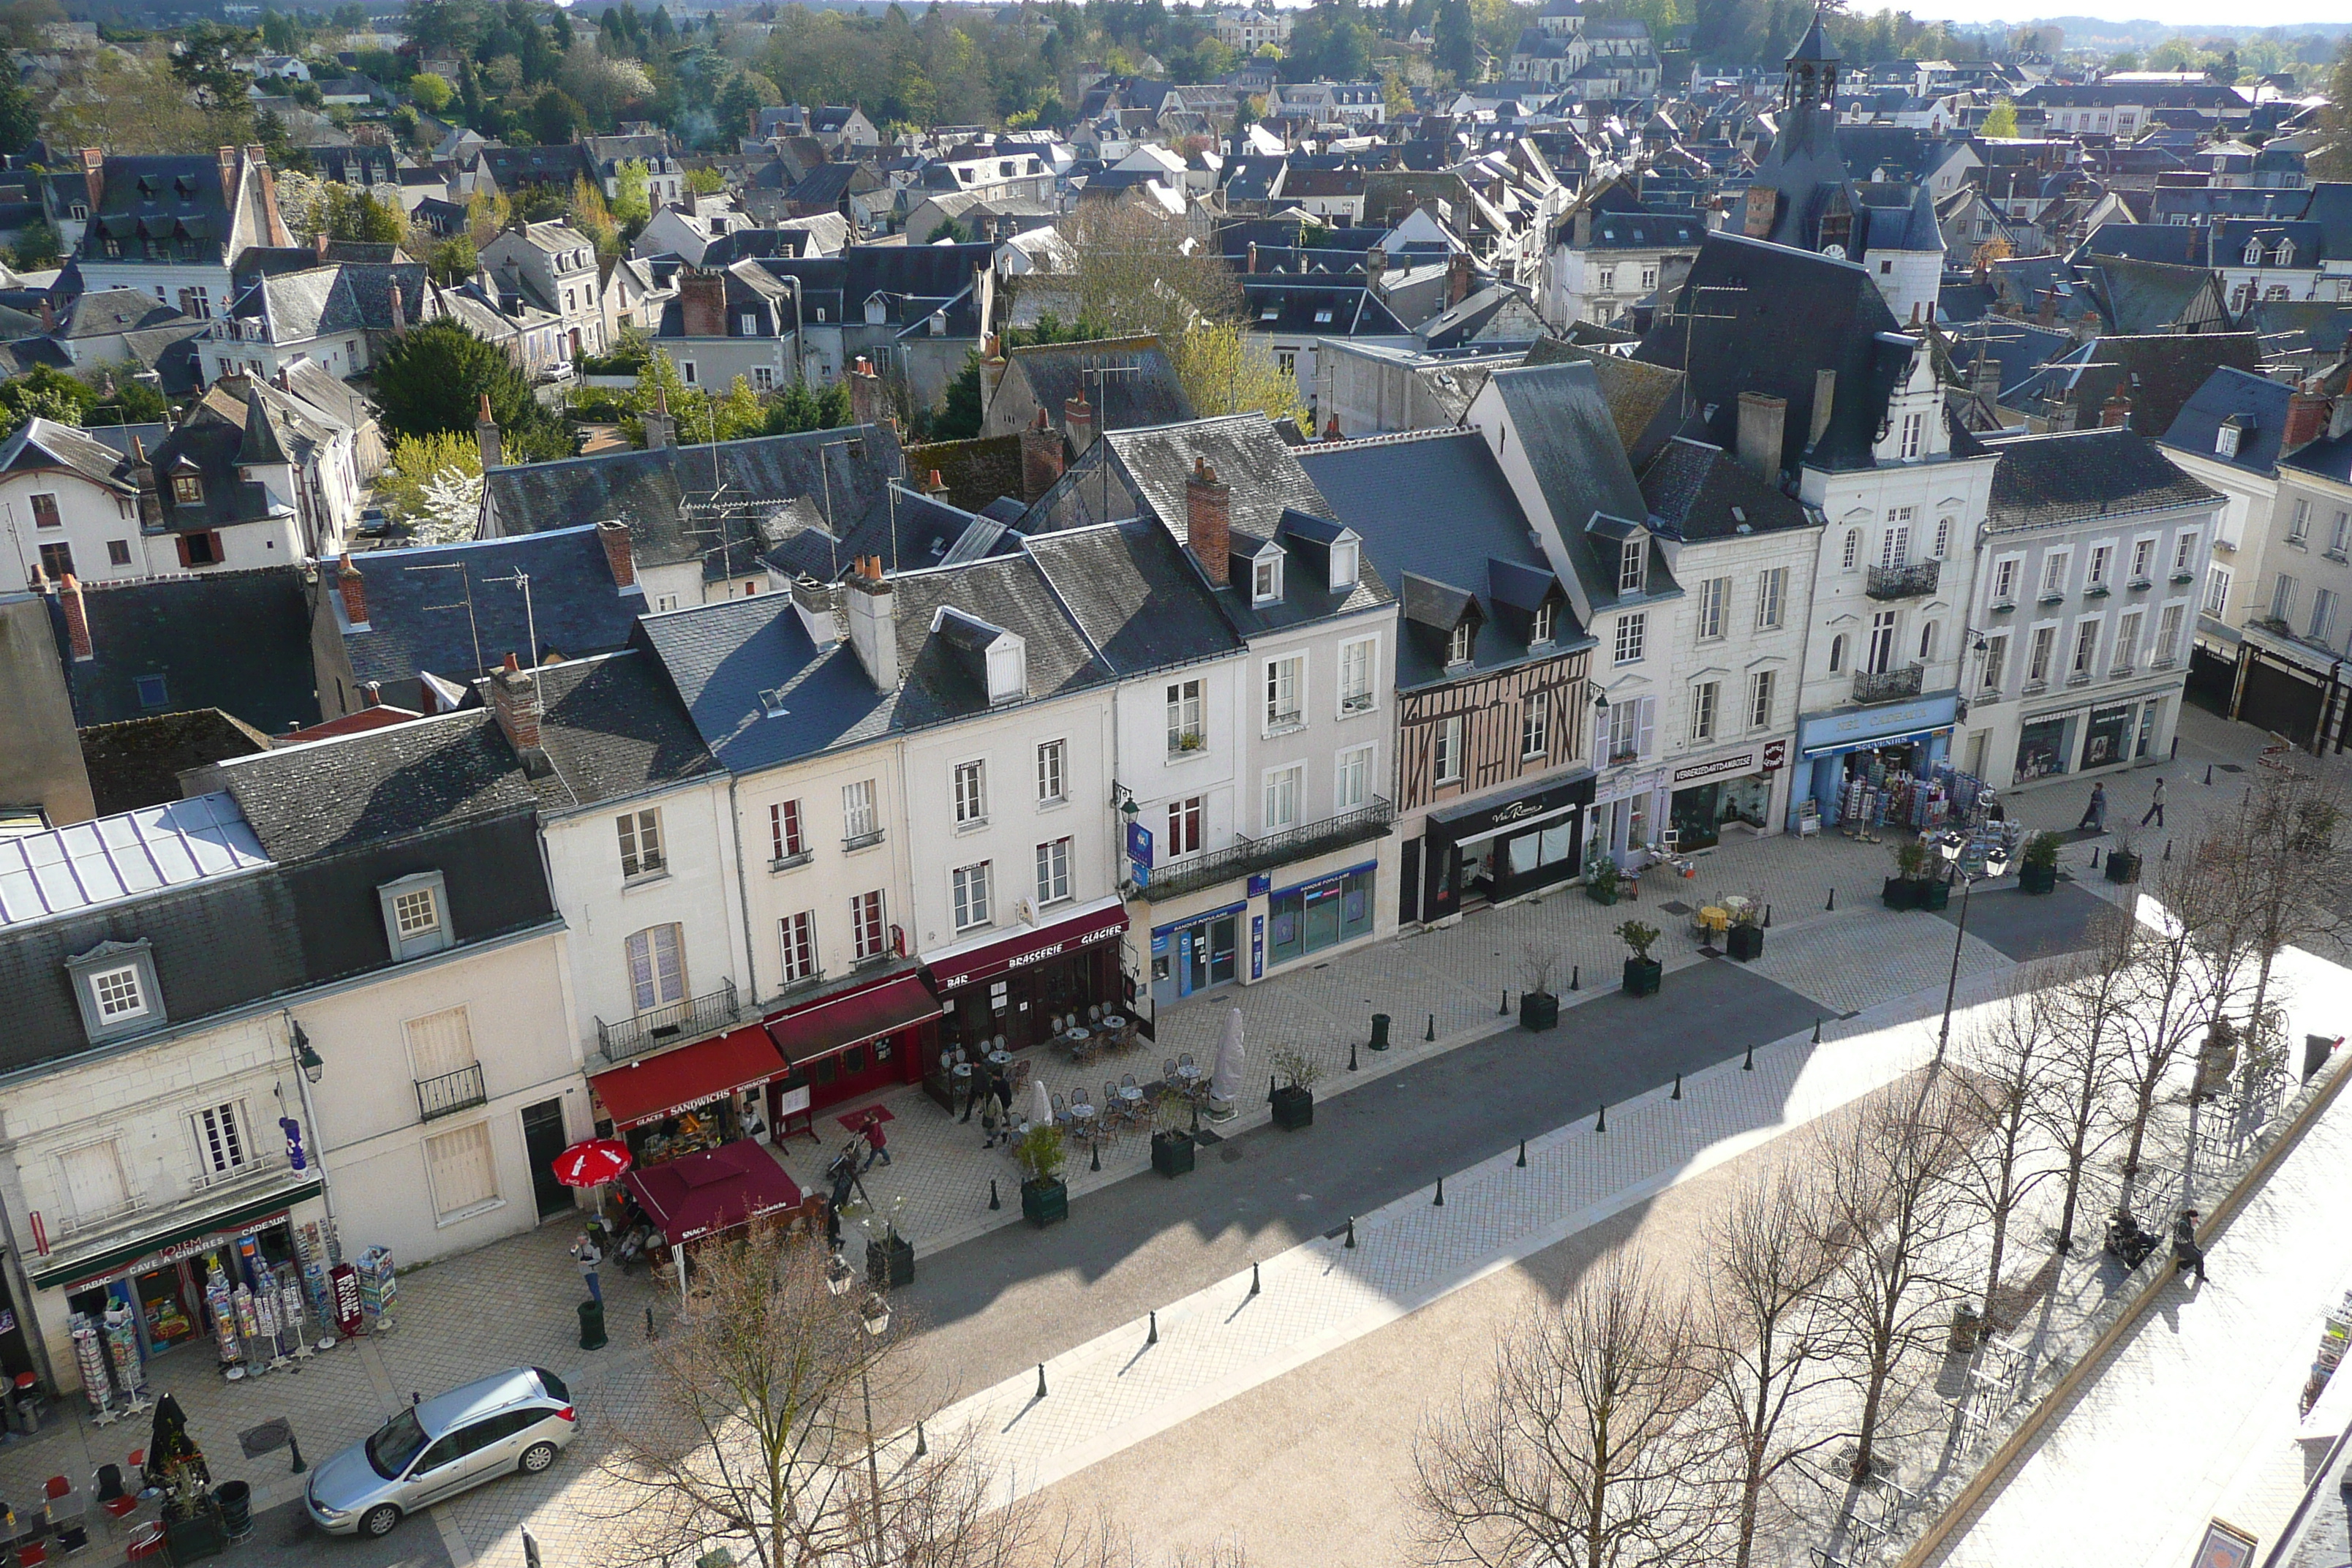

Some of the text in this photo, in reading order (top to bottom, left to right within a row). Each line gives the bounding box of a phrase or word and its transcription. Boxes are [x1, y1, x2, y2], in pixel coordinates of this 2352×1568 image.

[1855, 736, 1908, 751] SOUVENIRS
[1492, 811, 1508, 823] Via
[1174, 911, 1228, 932] BANQUE POPULAIRE
[1081, 924, 1122, 945] GLACIER
[1009, 943, 1063, 969] BRASSERIE
[946, 974, 969, 988] BAR
[736, 1077, 771, 1093] BOISSONS
[671, 1089, 731, 1116] SANDWICHS
[636, 1112, 664, 1126] GLACES
[241, 1215, 287, 1237] CADEAUX
[682, 1226, 707, 1240] SNACK
[129, 1259, 159, 1275] CAVE
[163, 1255, 172, 1264] A
[176, 1237, 225, 1259] CIGARES
[157, 1236, 202, 1259] TOTEM
[79, 1275, 113, 1292] TABAC
